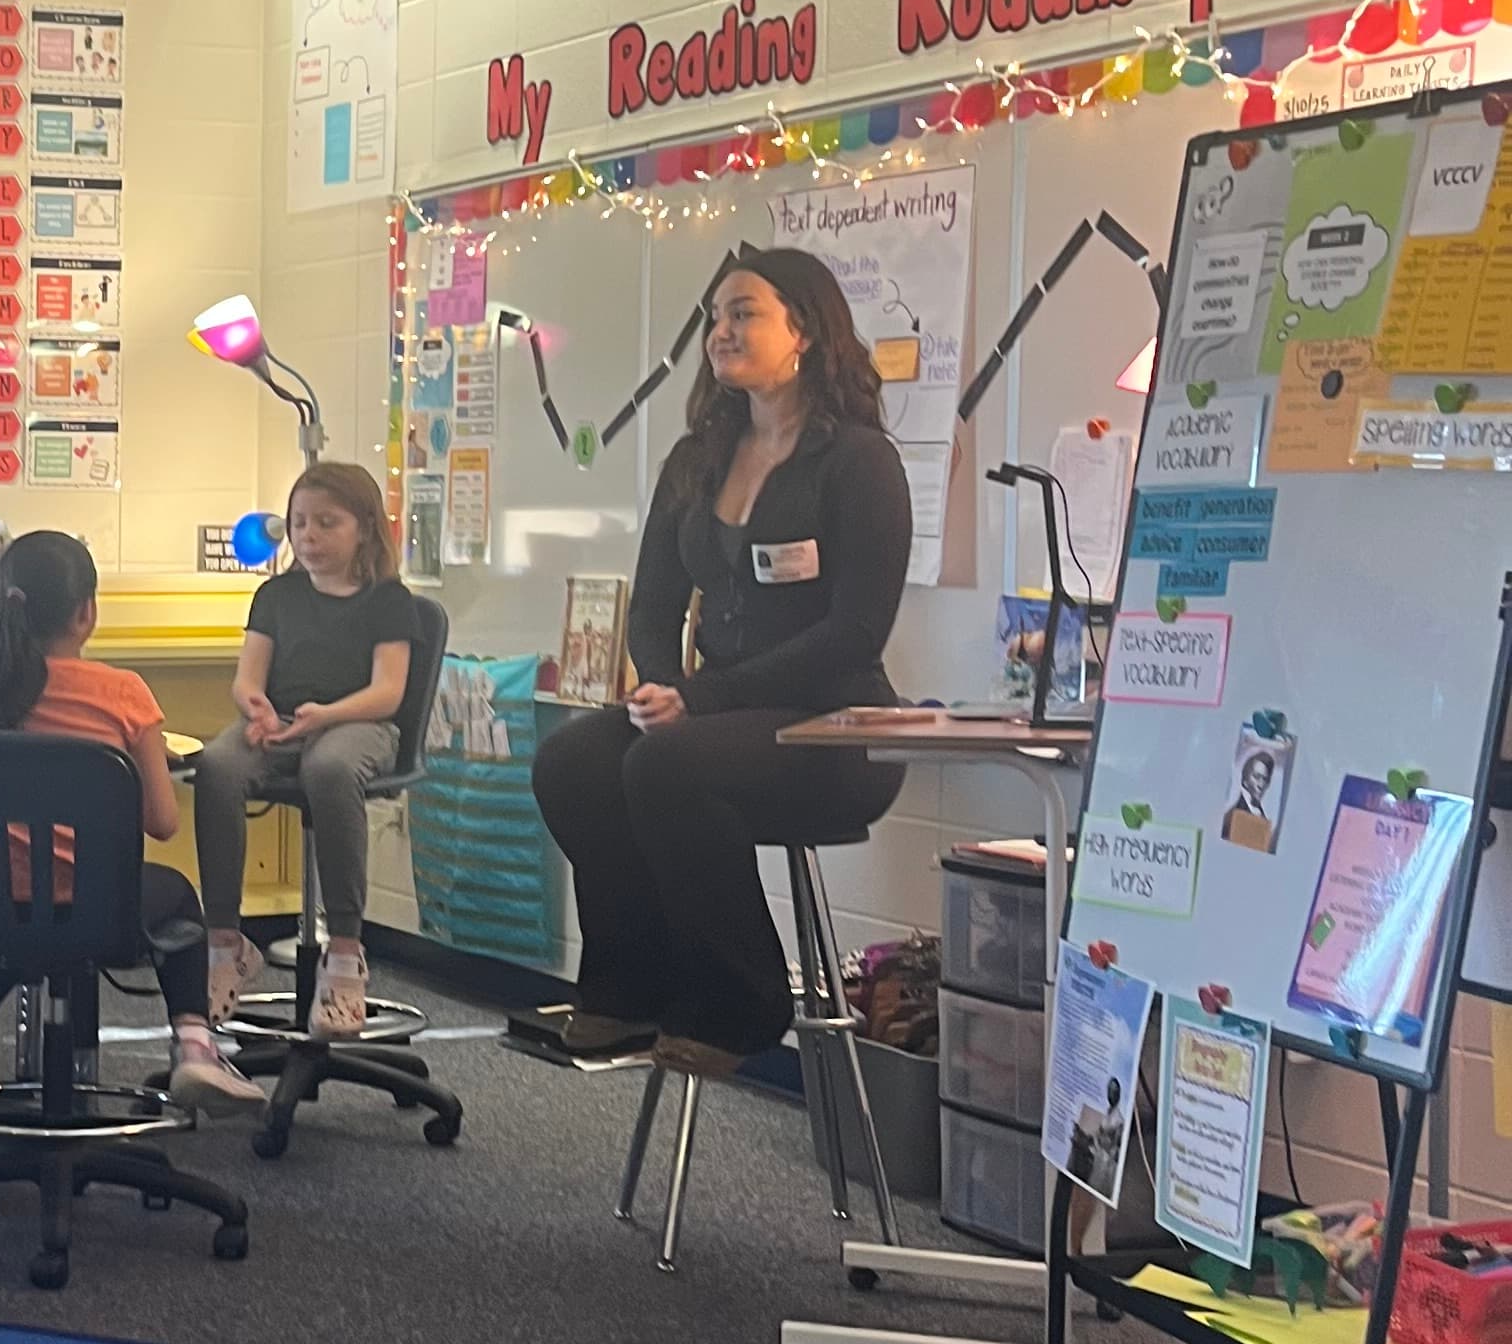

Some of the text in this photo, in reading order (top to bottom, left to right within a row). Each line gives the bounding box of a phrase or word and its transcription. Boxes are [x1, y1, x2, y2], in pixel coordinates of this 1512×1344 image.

[1390, 61, 1422, 79] DAILY
[1353, 84, 1407, 102] LEARNING
[488, 53, 551, 166] My
[1283, 93, 1330, 119] 3/10/25
[1432, 163, 1485, 187] VCCCV
[779, 182, 958, 238] text dependent writing
[1143, 494, 1274, 520] benefit generation
[1196, 536, 1267, 556] consumer
